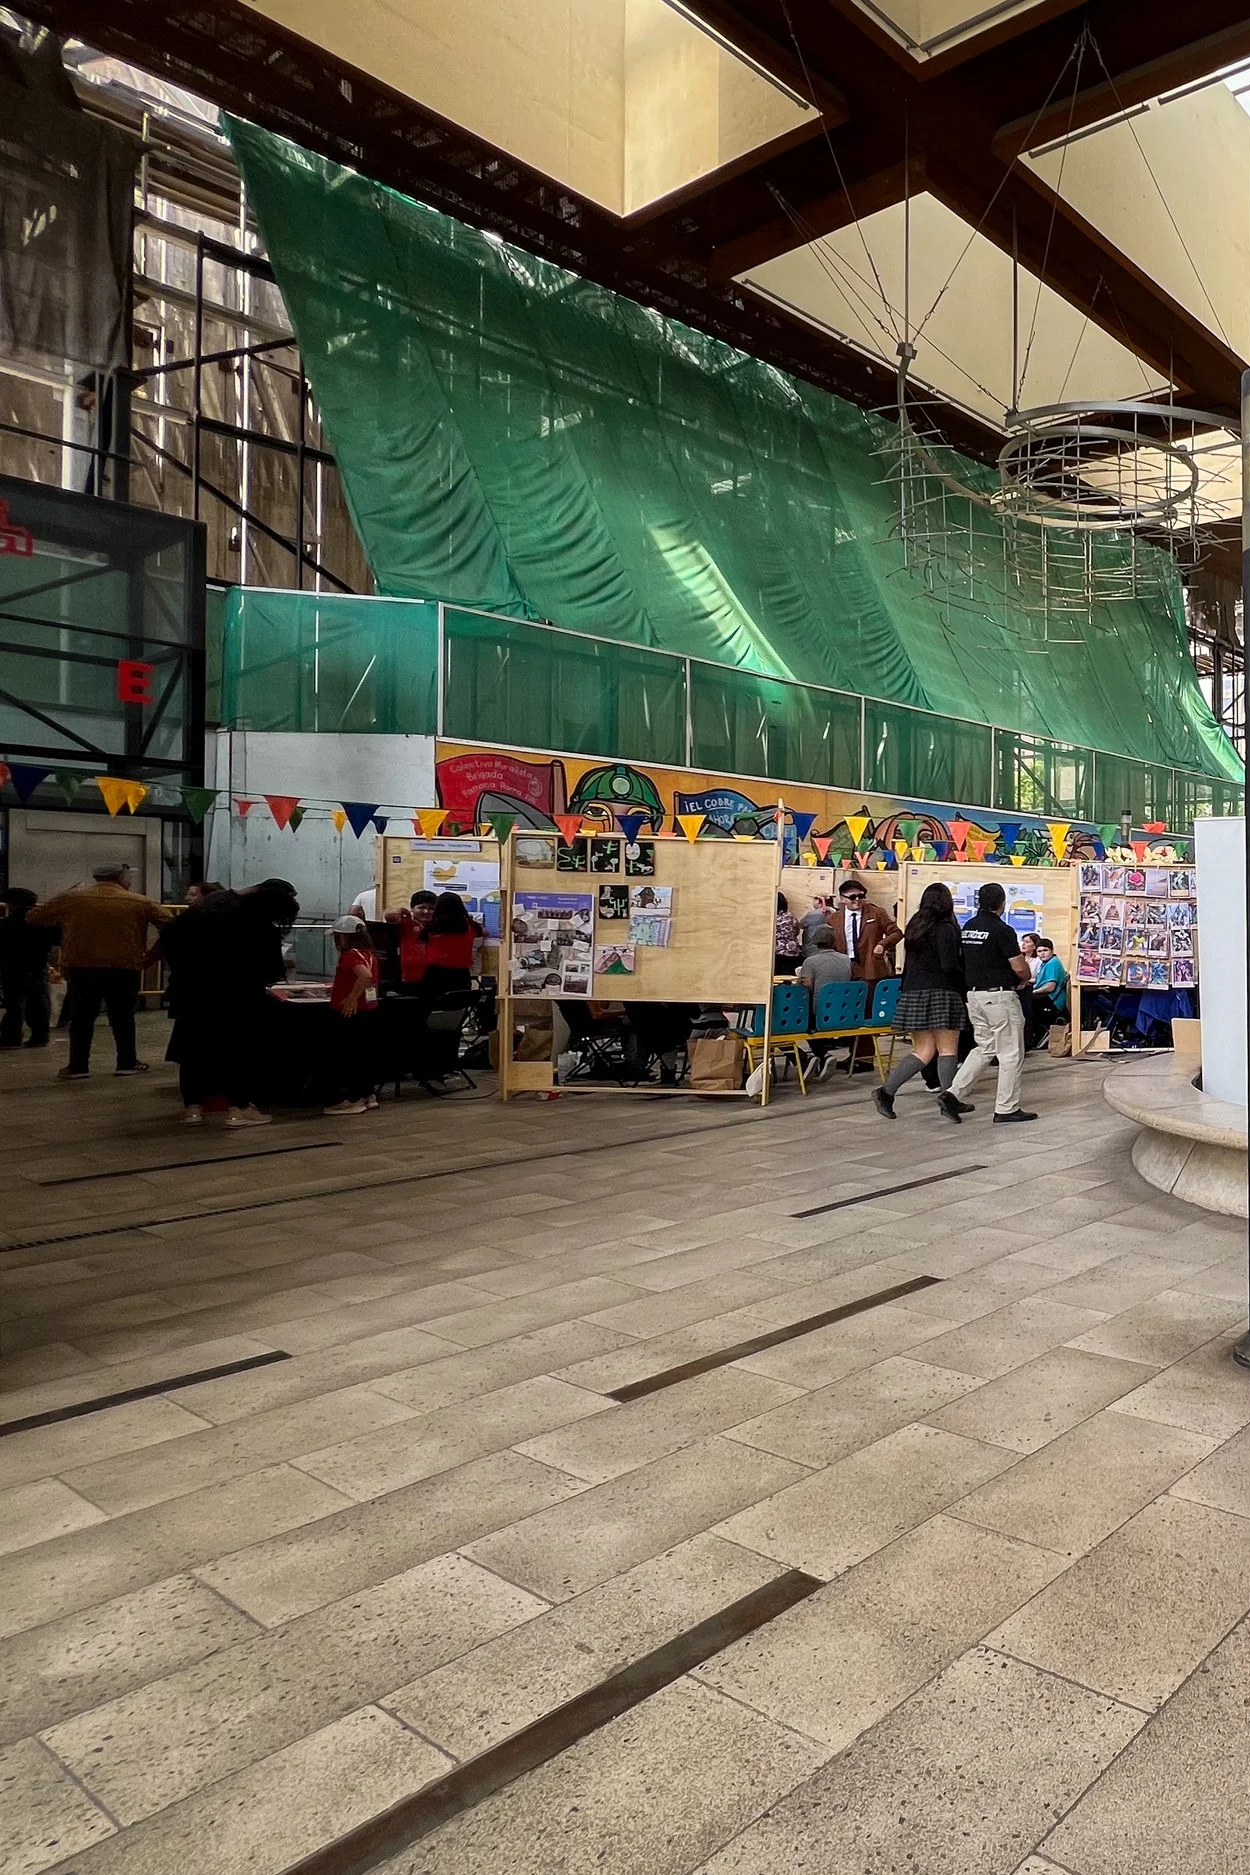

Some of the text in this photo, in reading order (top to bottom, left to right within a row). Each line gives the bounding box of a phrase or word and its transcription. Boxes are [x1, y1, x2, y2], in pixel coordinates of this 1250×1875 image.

[117, 659, 153, 704] E
[465, 771, 503, 782] Brigada
[704, 797, 736, 809] COBRE
